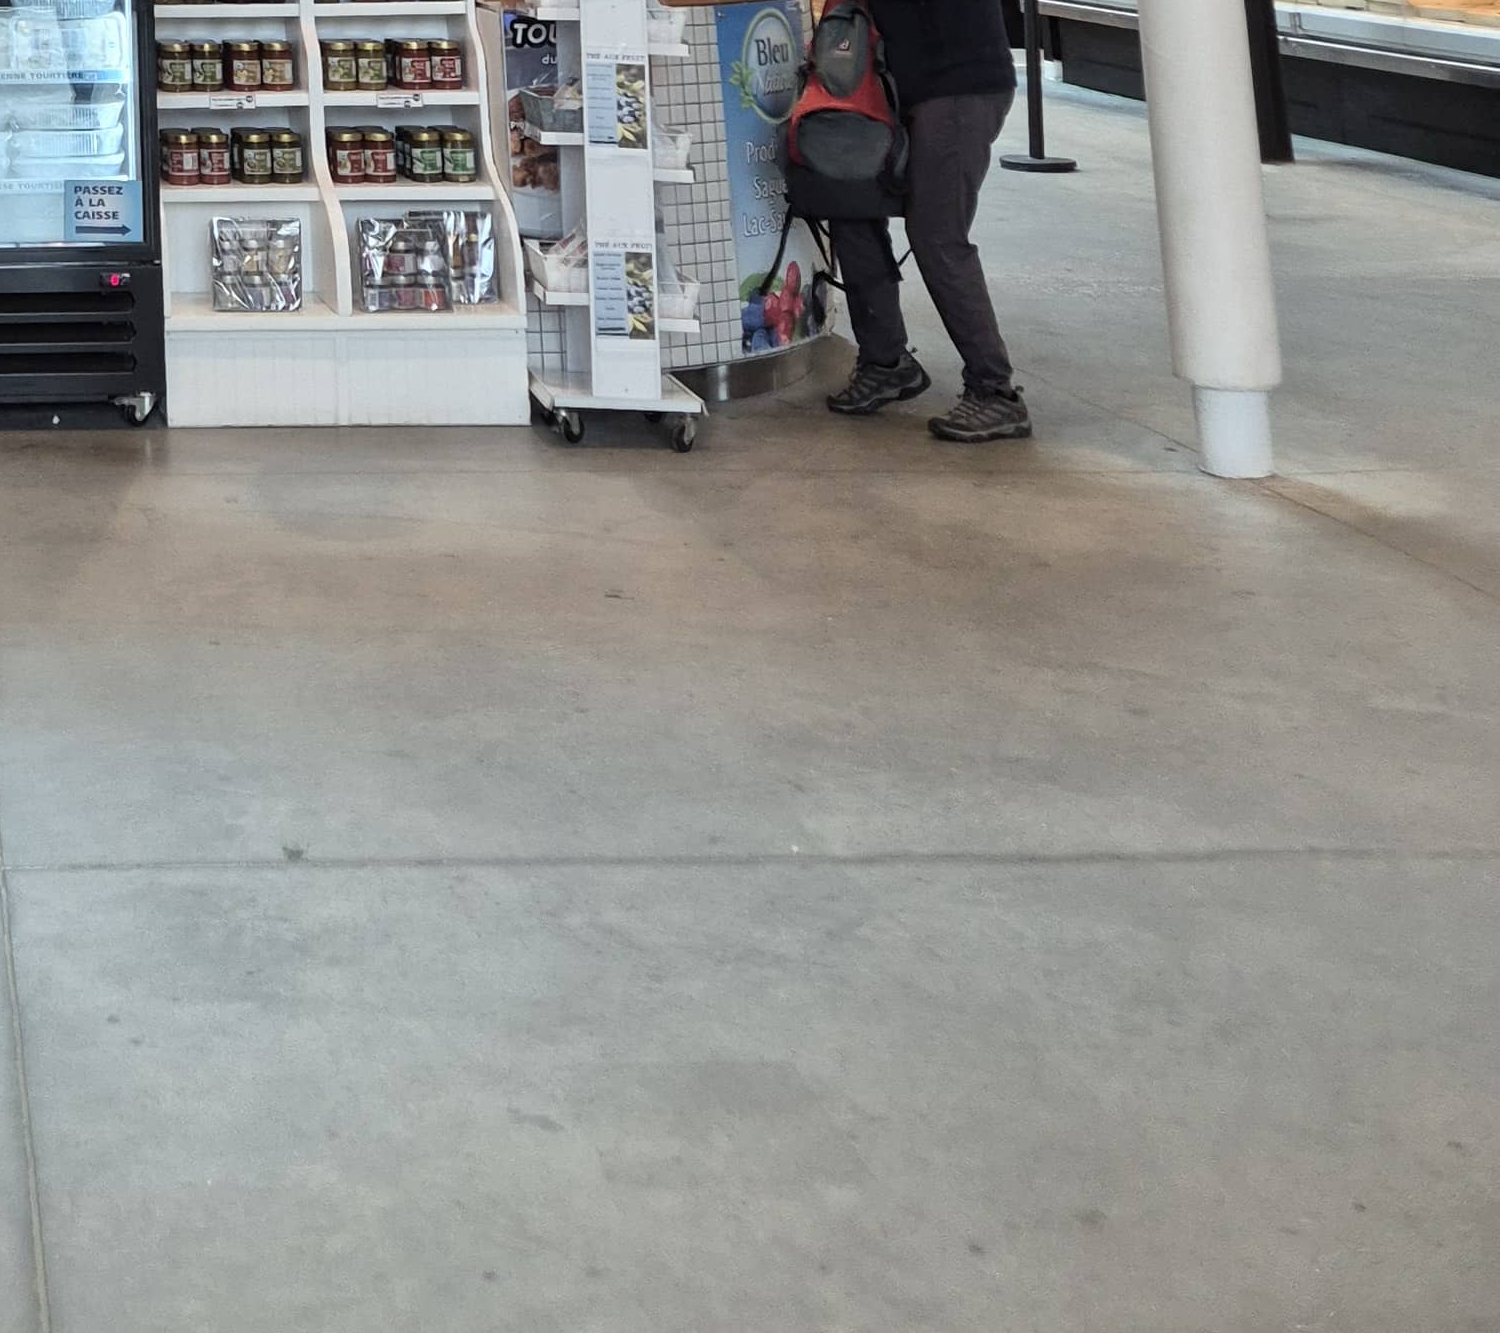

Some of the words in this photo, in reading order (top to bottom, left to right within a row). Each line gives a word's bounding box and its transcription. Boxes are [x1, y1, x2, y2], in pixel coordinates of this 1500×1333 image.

[755, 38, 790, 66] Bleu
[74, 185, 123, 195] PASSEZ
[89, 198, 106, 207] LA
[74, 211, 120, 220] CAISSE
